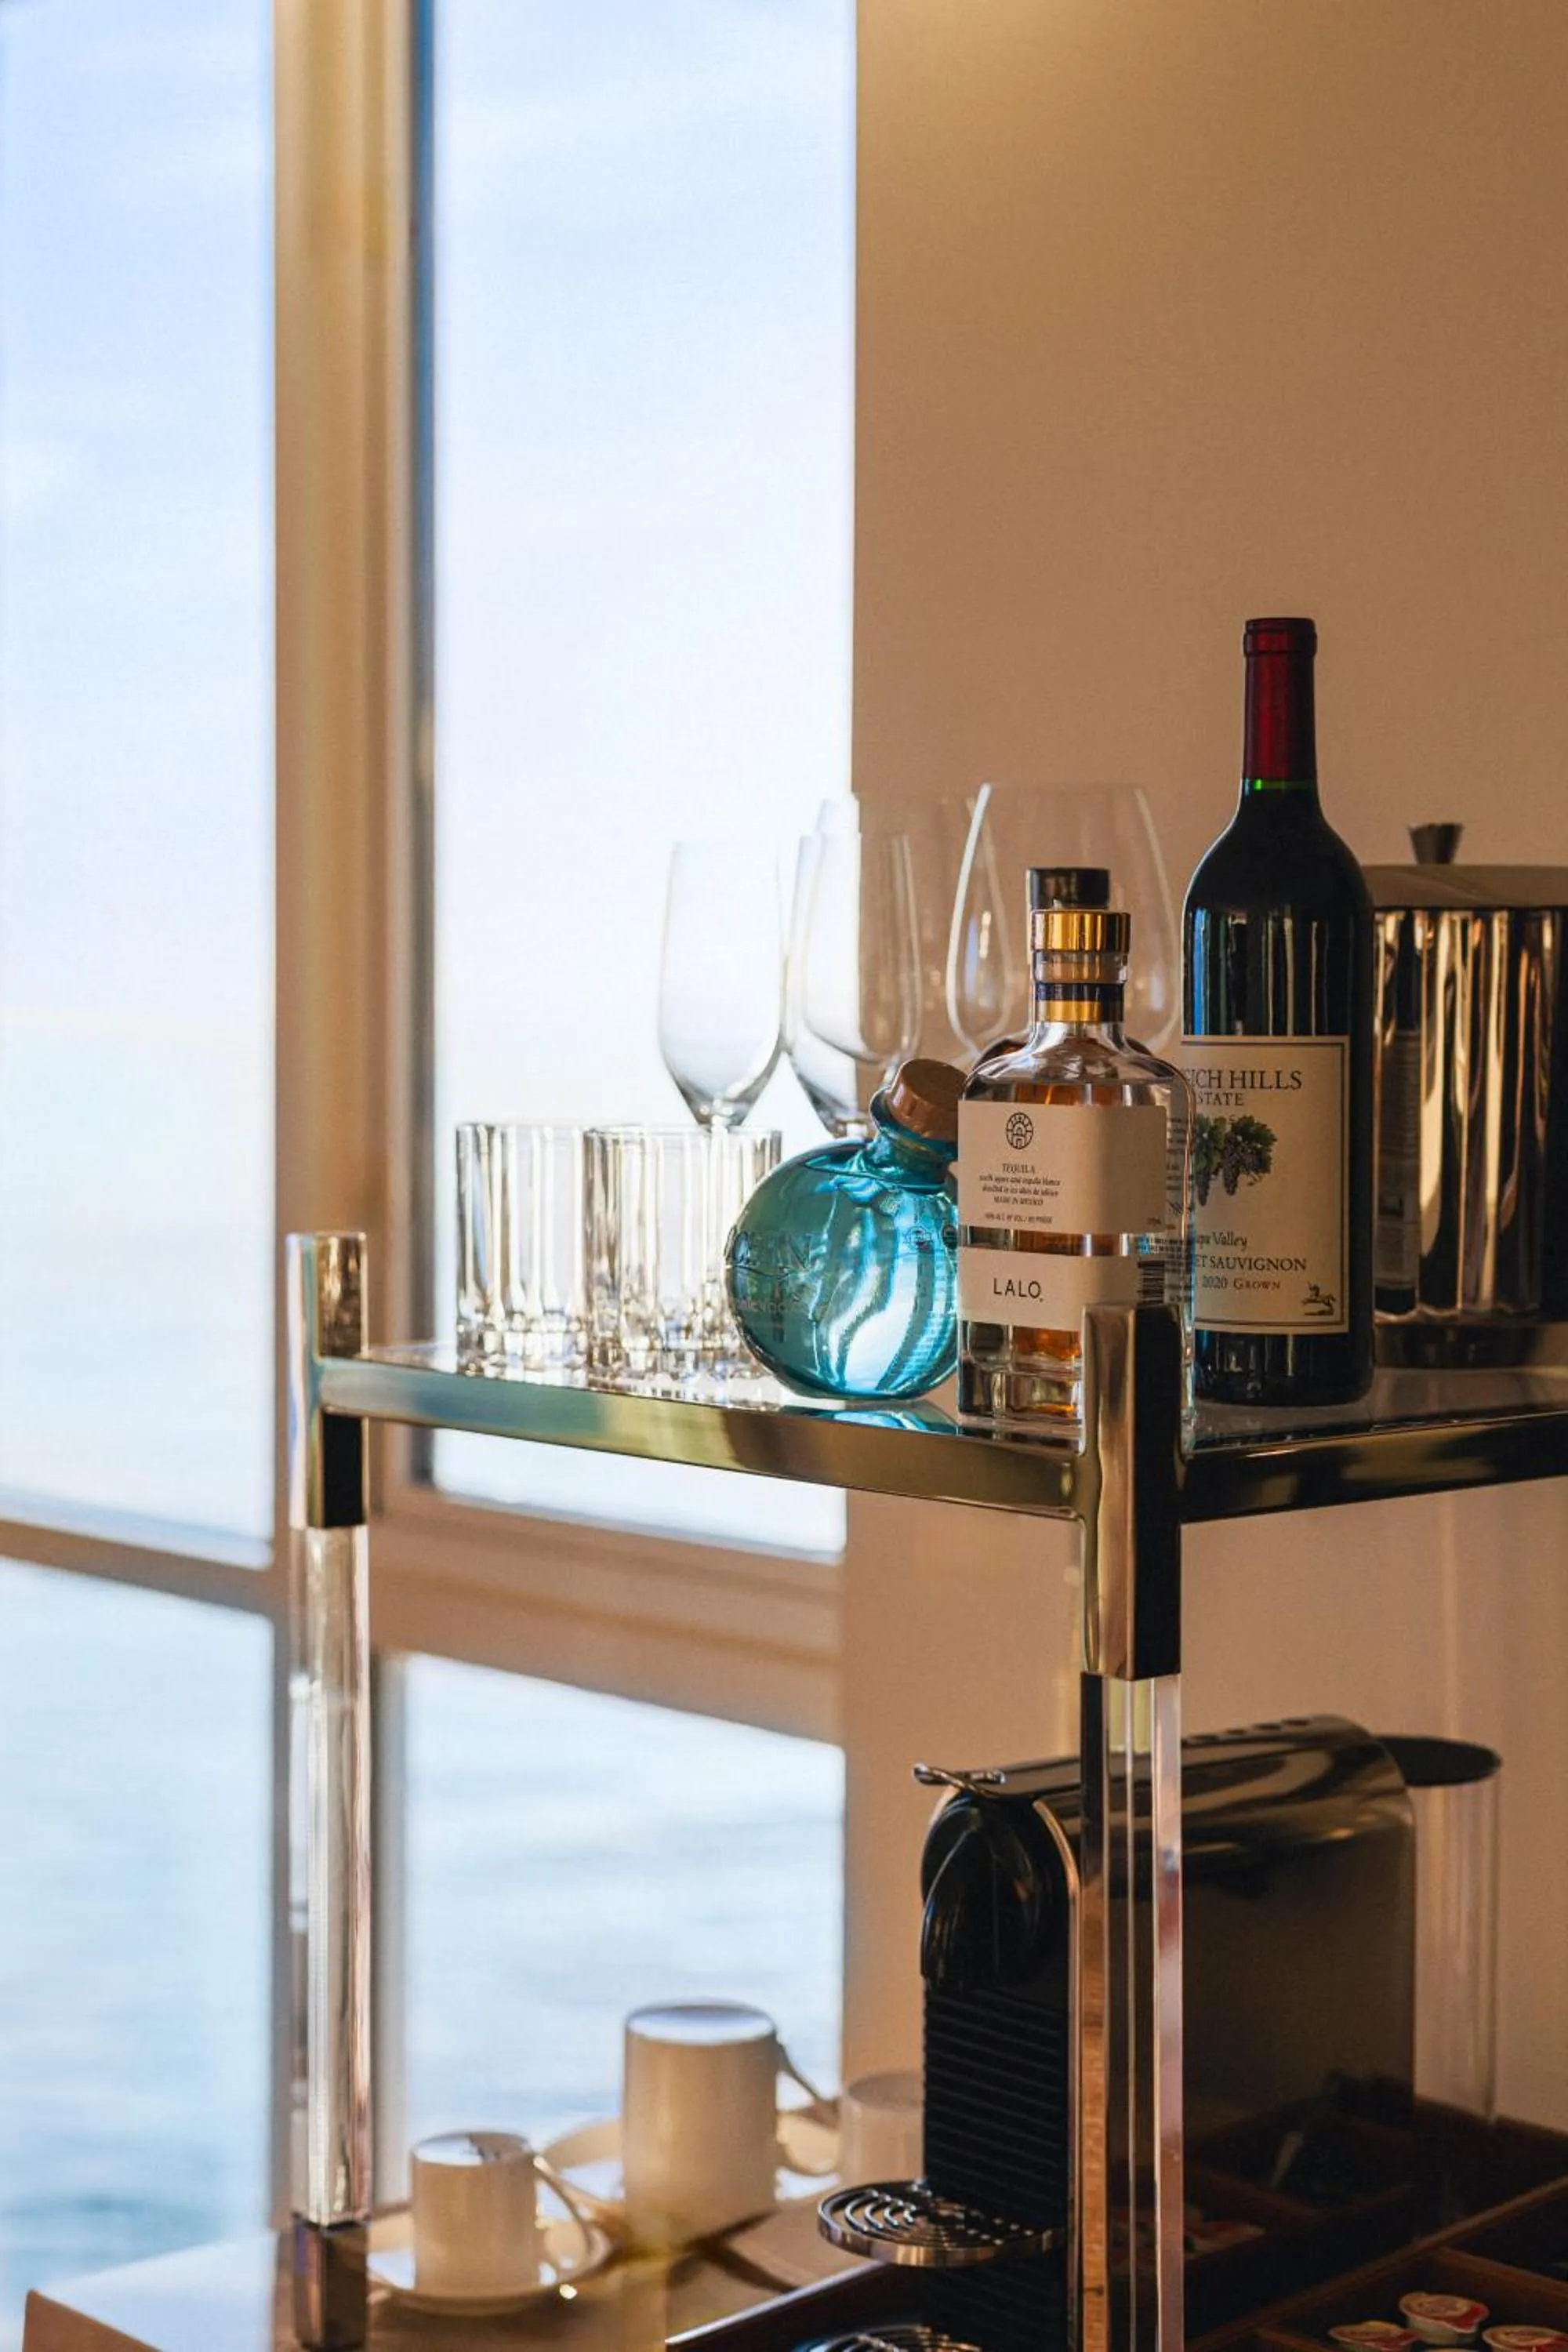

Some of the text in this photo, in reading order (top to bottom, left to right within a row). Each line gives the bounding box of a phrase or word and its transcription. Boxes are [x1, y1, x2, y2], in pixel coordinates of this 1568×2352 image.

[1229, 1069, 1302, 1090] HILLS
[1002, 1163, 1035, 1174] TEQUILA
[1212, 1231, 1247, 1251] Valley
[1209, 1255, 1306, 1271] SAUVIGNON
[993, 1277, 1041, 1299] LALO
[1202, 1276, 1228, 1290] 2020
